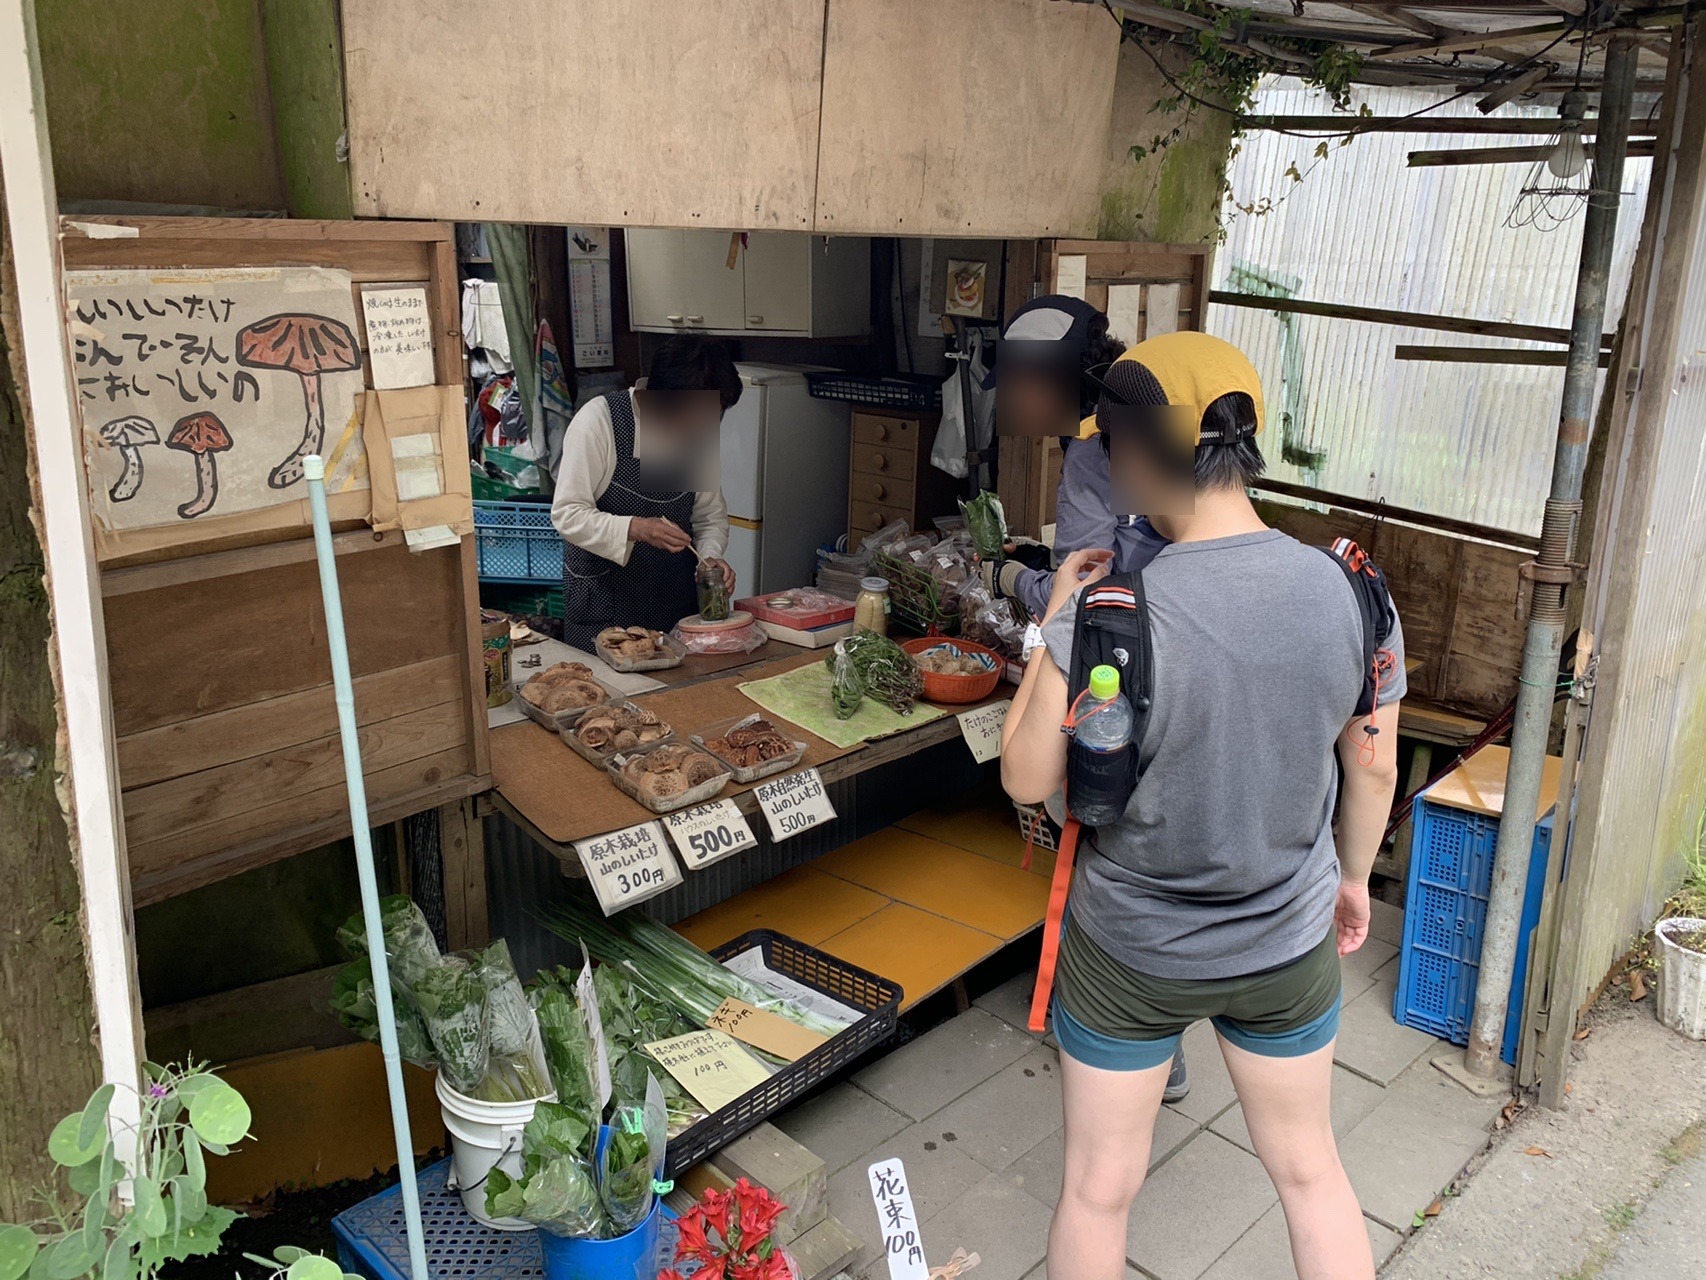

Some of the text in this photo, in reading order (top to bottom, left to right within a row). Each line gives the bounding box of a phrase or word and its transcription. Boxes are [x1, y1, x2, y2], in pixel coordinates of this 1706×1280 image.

[758, 770, 816, 802] 原木自然発生
[771, 781, 822, 815] 山のしいたけ
[779, 811, 816, 833] 500円
[590, 827, 652, 861] 原木栽培
[600, 842, 659, 876] 山のしいたけ
[688, 824, 747, 860] 500円
[617, 867, 664, 894] 300円
[728, 1008, 754, 1033] 100円
[694, 1060, 728, 1077] 100円
[872, 1167, 912, 1229] 花束
[885, 1230, 922, 1265] 100円
